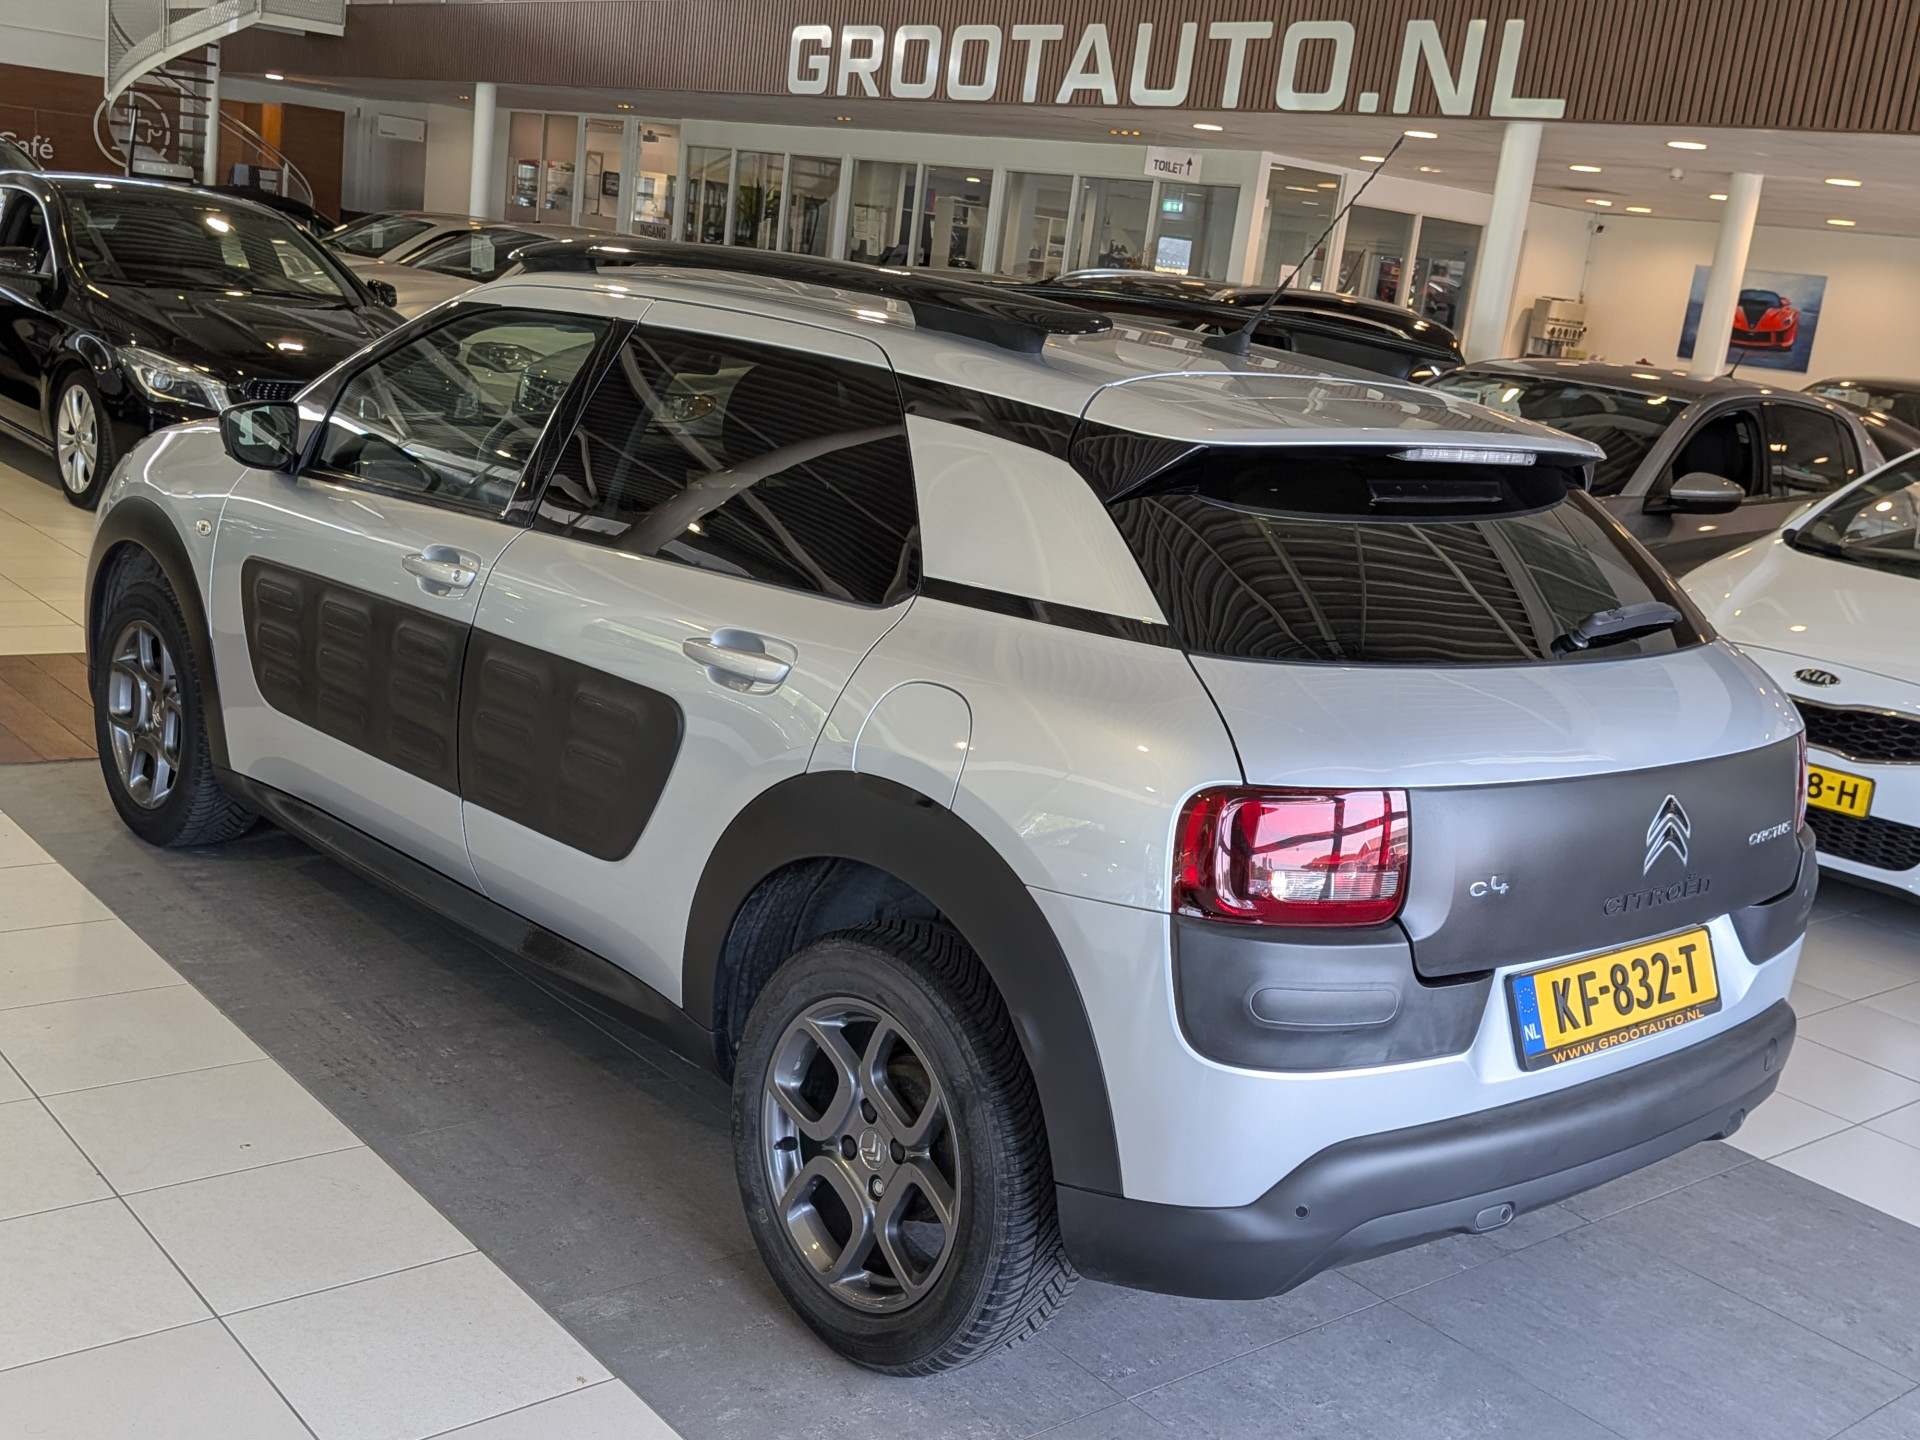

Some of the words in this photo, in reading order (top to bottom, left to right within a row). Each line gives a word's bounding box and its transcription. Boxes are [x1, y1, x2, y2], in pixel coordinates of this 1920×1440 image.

[787, 19, 1566, 119] GROOTAUTO.NL
[1153, 159, 1184, 175] TOILET
[641, 224, 666, 239] INGANG
[1799, 670, 1832, 685] KIA
[1749, 820, 1791, 845] CACTUS
[1469, 875, 1510, 897] C4
[1603, 874, 1711, 915] CITROËN
[1551, 943, 1697, 1034] KF-832-T
[1524, 1023, 1541, 1042] NL
[1552, 1008, 1705, 1064] WWW.GROOTAUTO.NL
